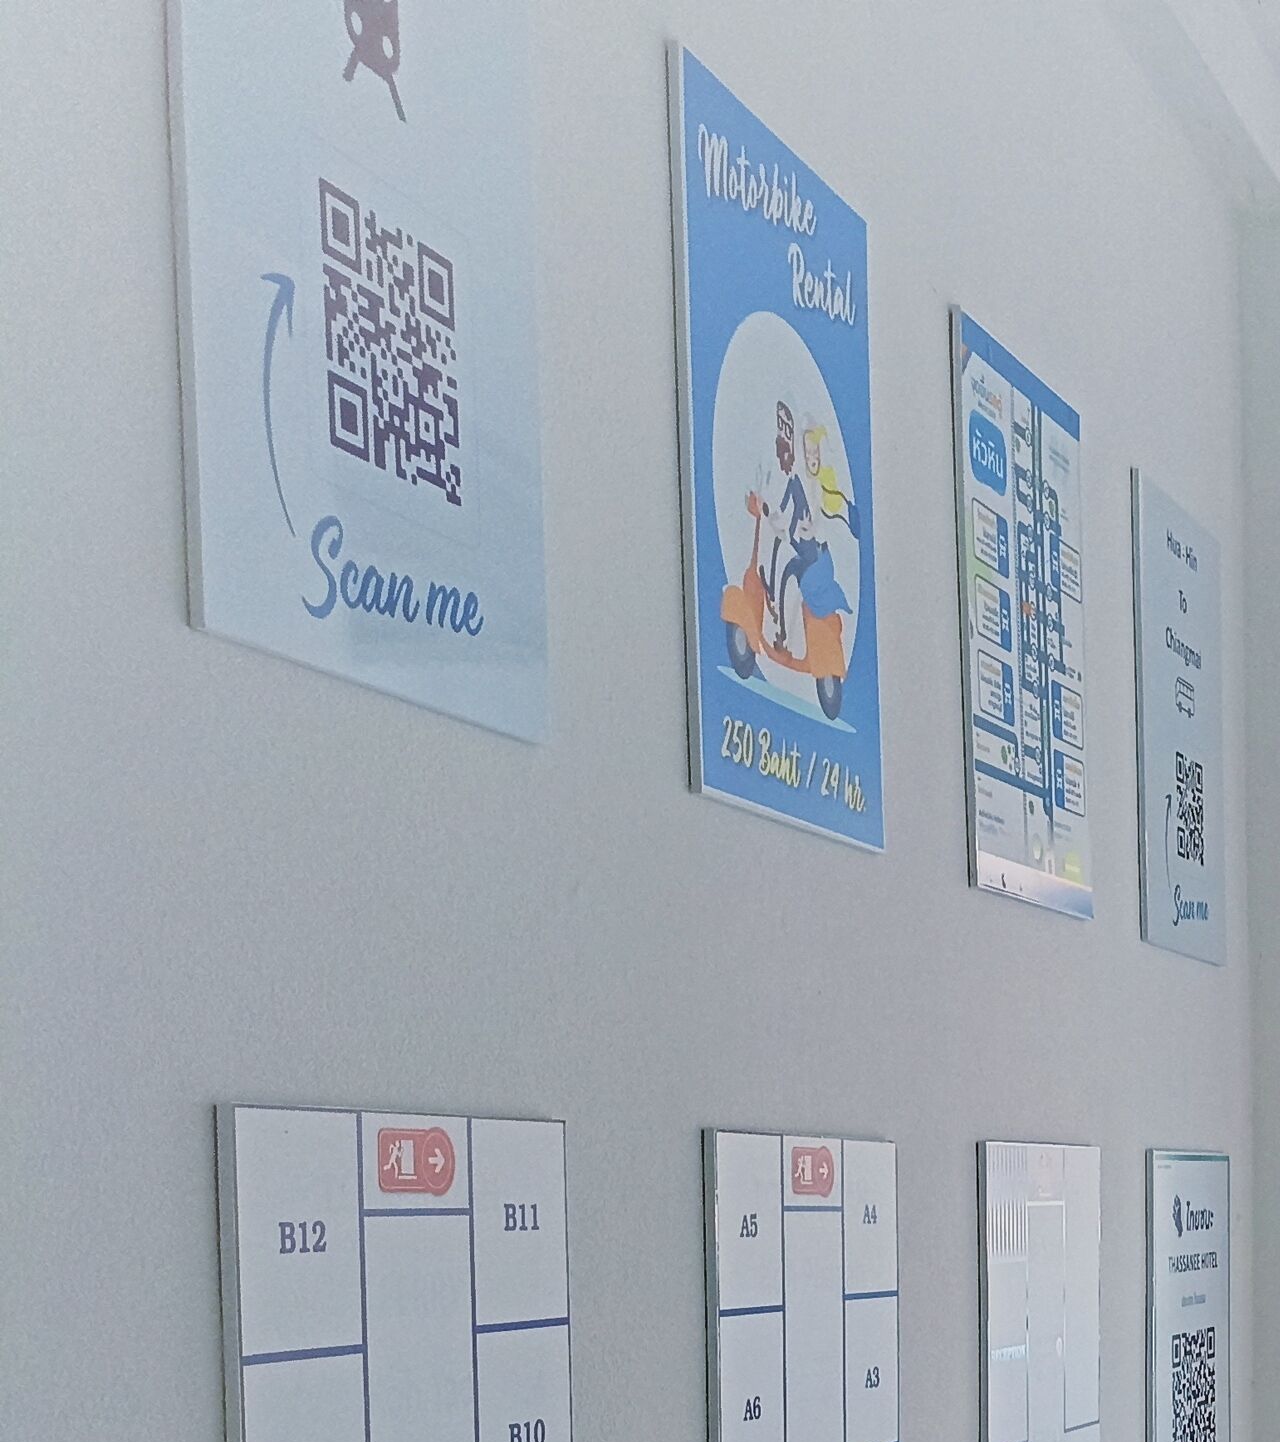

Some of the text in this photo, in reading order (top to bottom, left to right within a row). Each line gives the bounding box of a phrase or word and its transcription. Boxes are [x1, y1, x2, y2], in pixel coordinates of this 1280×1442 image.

[698, 123, 817, 236] Motorbike
[788, 242, 856, 326] Rental
[302, 515, 485, 637] Scan me
[1178, 589, 1188, 614] To
[721, 715, 753, 768] 250
[758, 728, 801, 788] Baht
[821, 758, 841, 800] 24
[1172, 884, 1209, 927] Scan me
[503, 1203, 541, 1232] B11
[739, 1213, 759, 1238] A5
[862, 1203, 879, 1225] A4
[278, 1220, 328, 1254] B12
[1201, 1251, 1218, 1269] HOTEL
[865, 1366, 880, 1389] A3
[743, 1395, 762, 1422] A6
